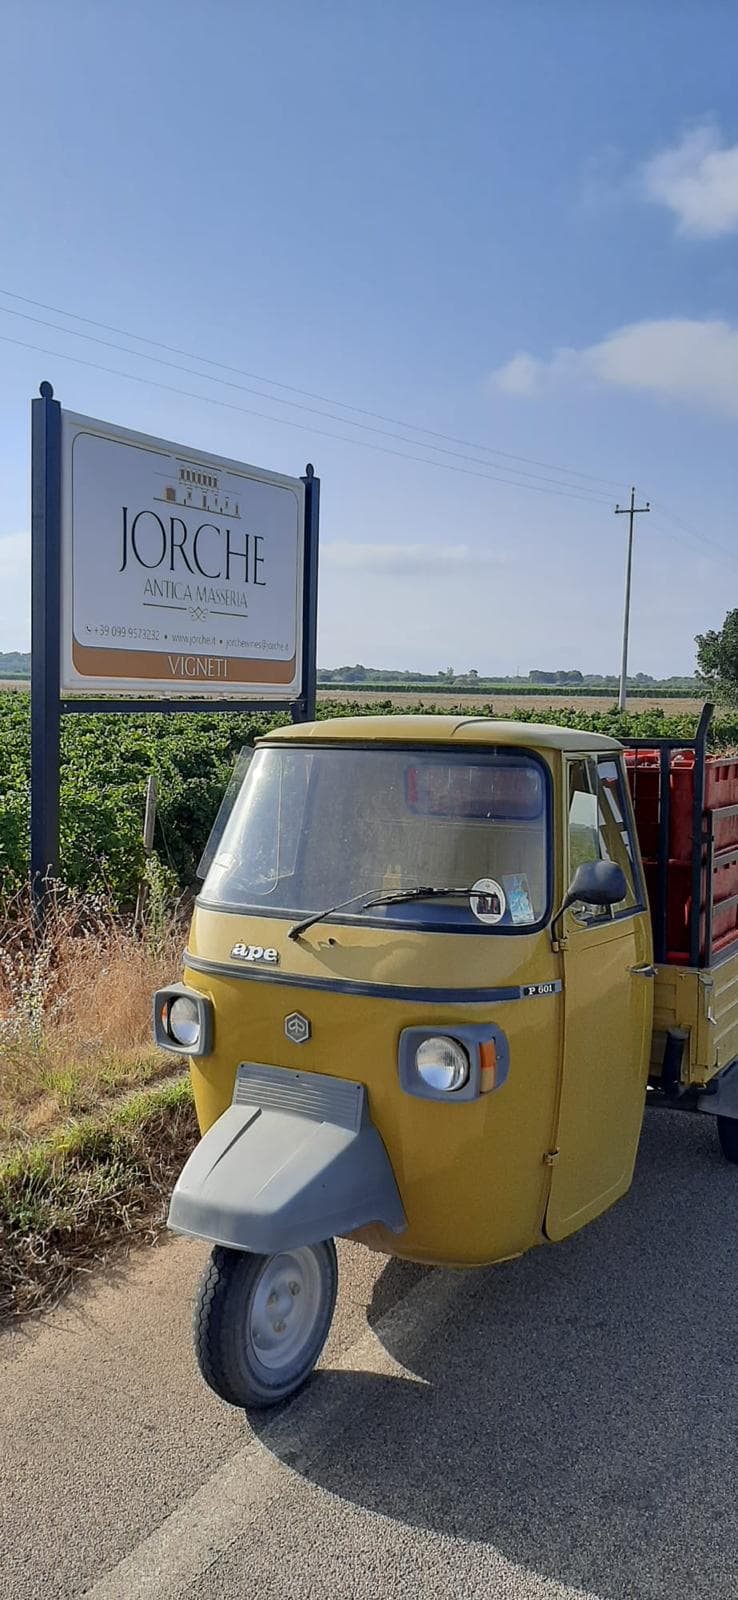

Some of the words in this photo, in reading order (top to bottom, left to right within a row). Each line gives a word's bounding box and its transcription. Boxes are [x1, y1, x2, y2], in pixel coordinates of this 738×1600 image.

[119, 506, 266, 586] JORCHE
[143, 578, 192, 601] ANTICA
[196, 585, 248, 608] MASSERIA
[168, 655, 228, 677] VIGNETI
[231, 942, 279, 963] ape
[528, 986, 536, 996] P
[538, 984, 553, 994] 601
